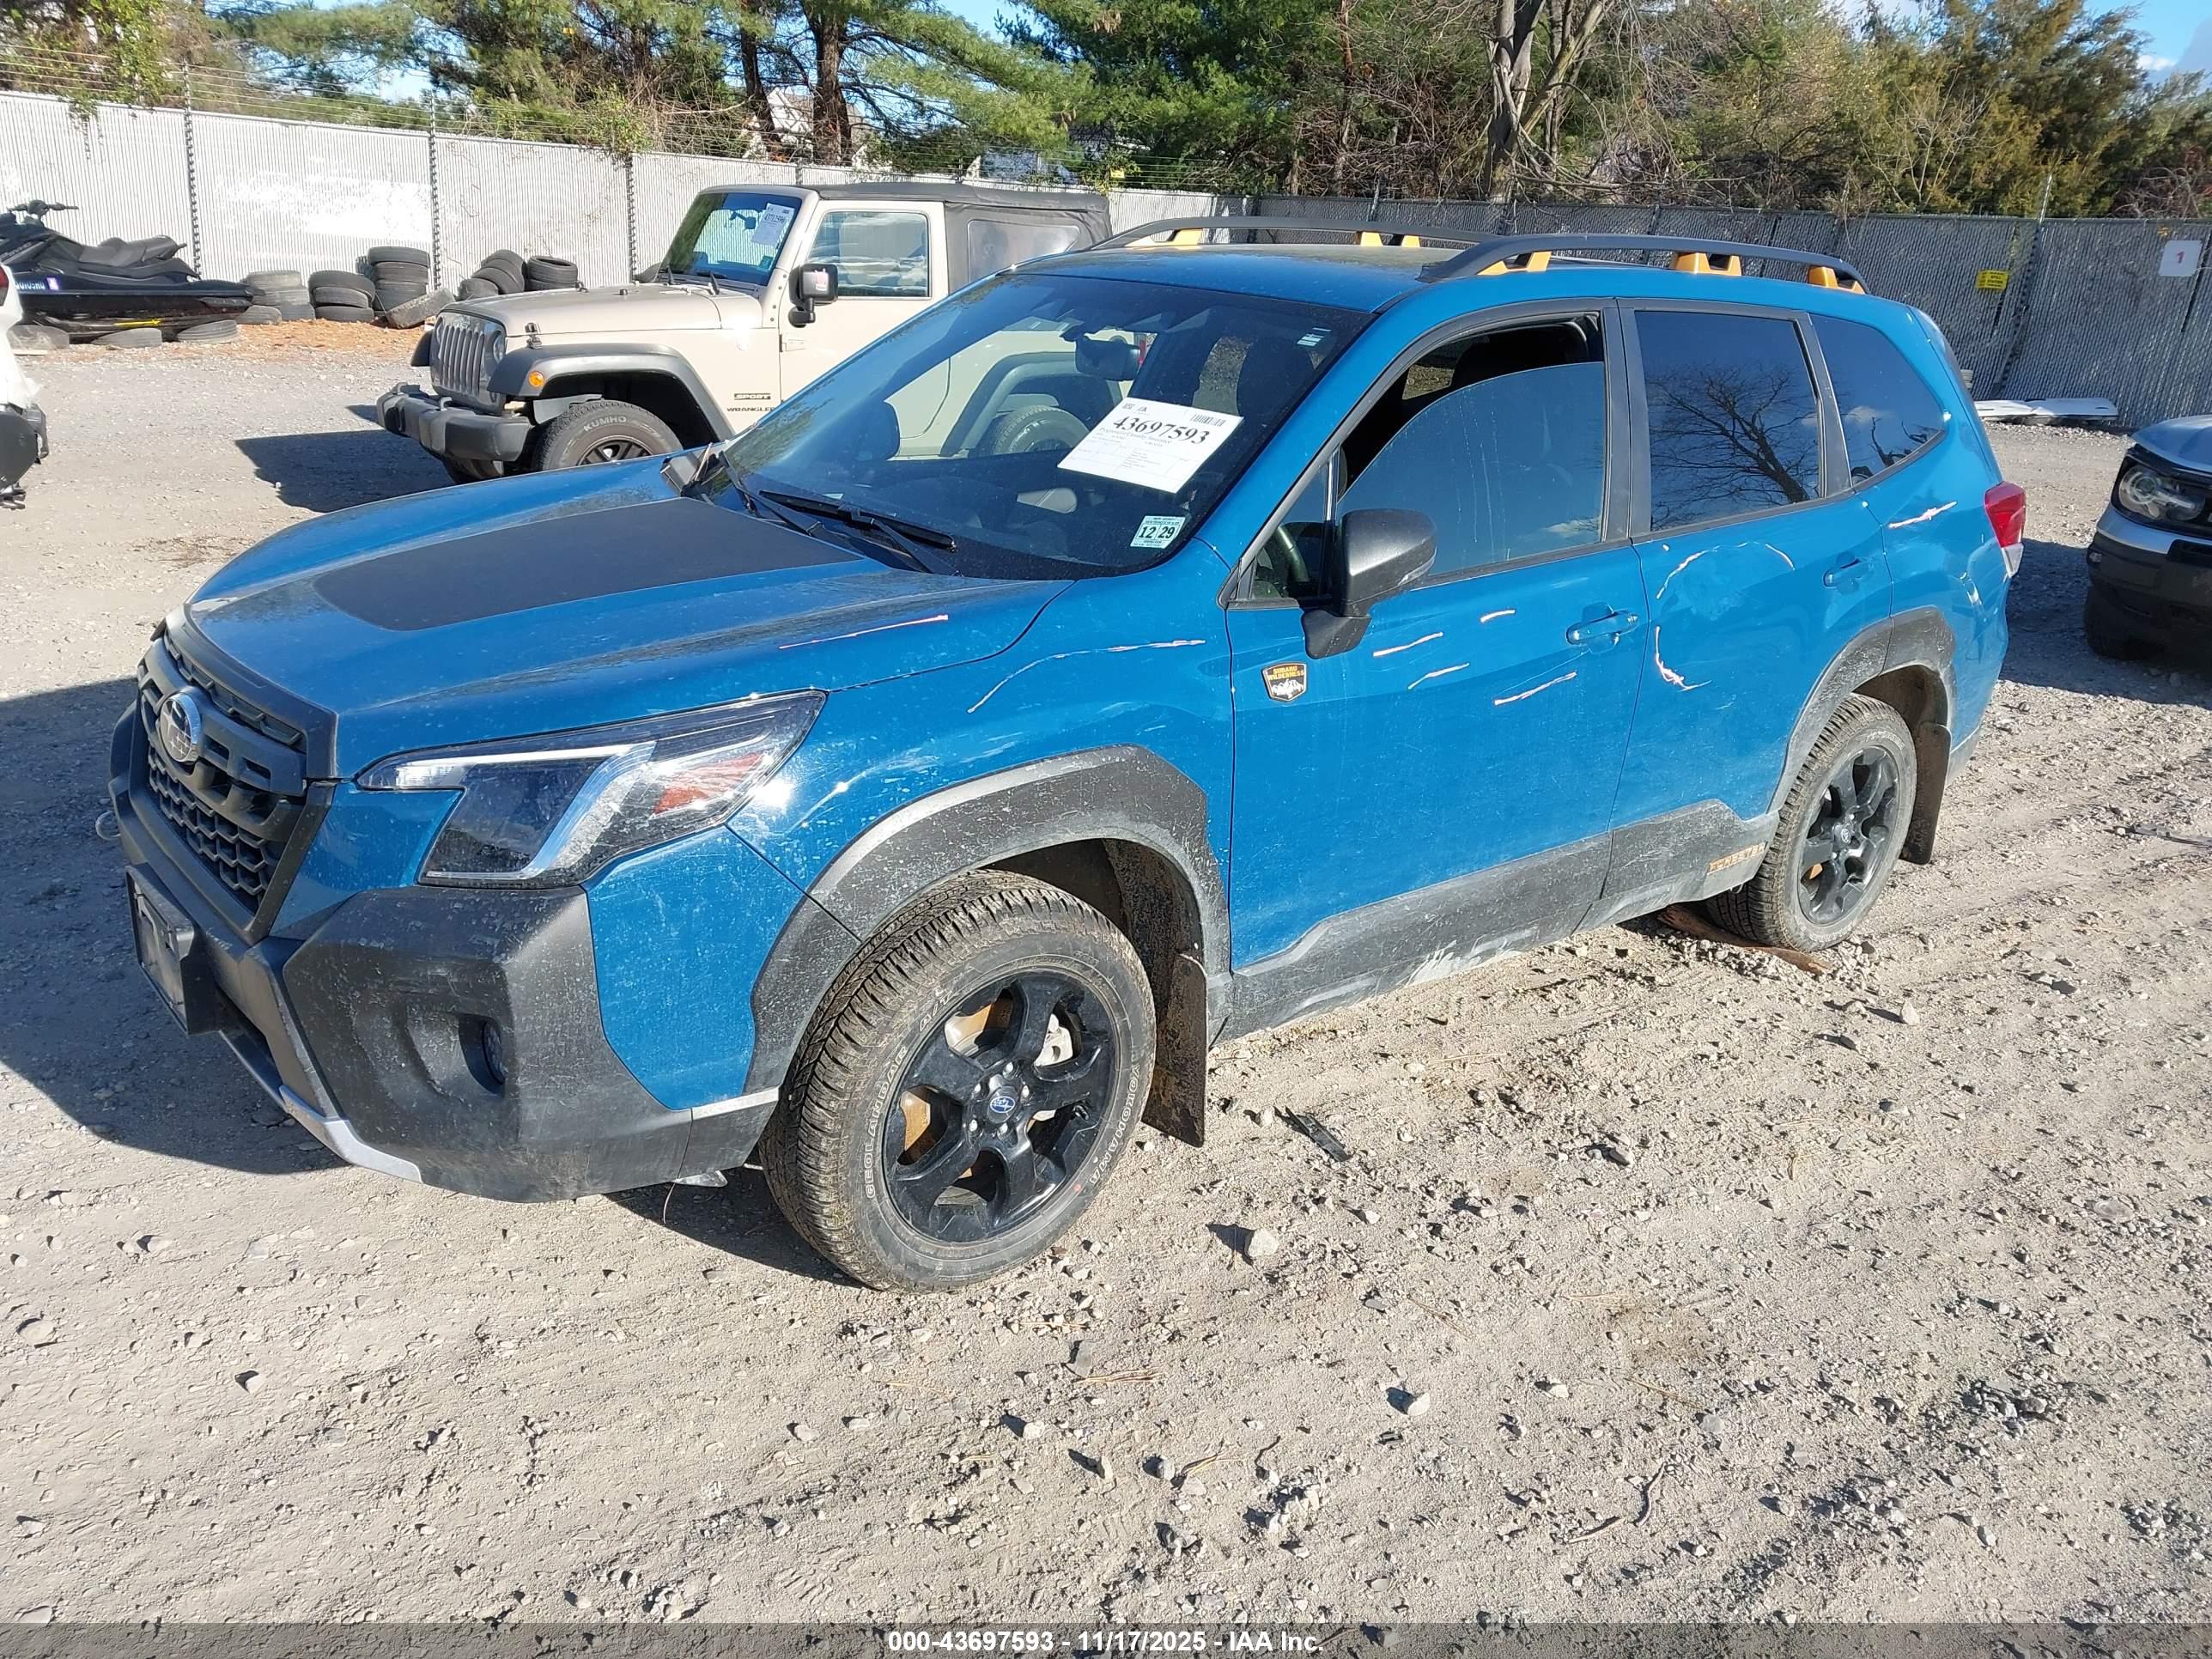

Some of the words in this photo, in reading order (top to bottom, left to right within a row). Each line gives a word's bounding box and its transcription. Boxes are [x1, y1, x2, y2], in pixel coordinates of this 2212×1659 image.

[2177, 251, 2185, 264] 1
[583, 416, 627, 432] KUMHO
[1112, 415, 1212, 445] 43697593
[1139, 526, 1157, 539] 12
[1157, 526, 1176, 539] 29
[1267, 670, 1305, 681] WILDERNESS
[1273, 665, 1297, 674] SUBARU
[865, 1046, 908, 1199] GEOLANDAR
[1089, 1064, 1140, 1185] YOKOHAMA
